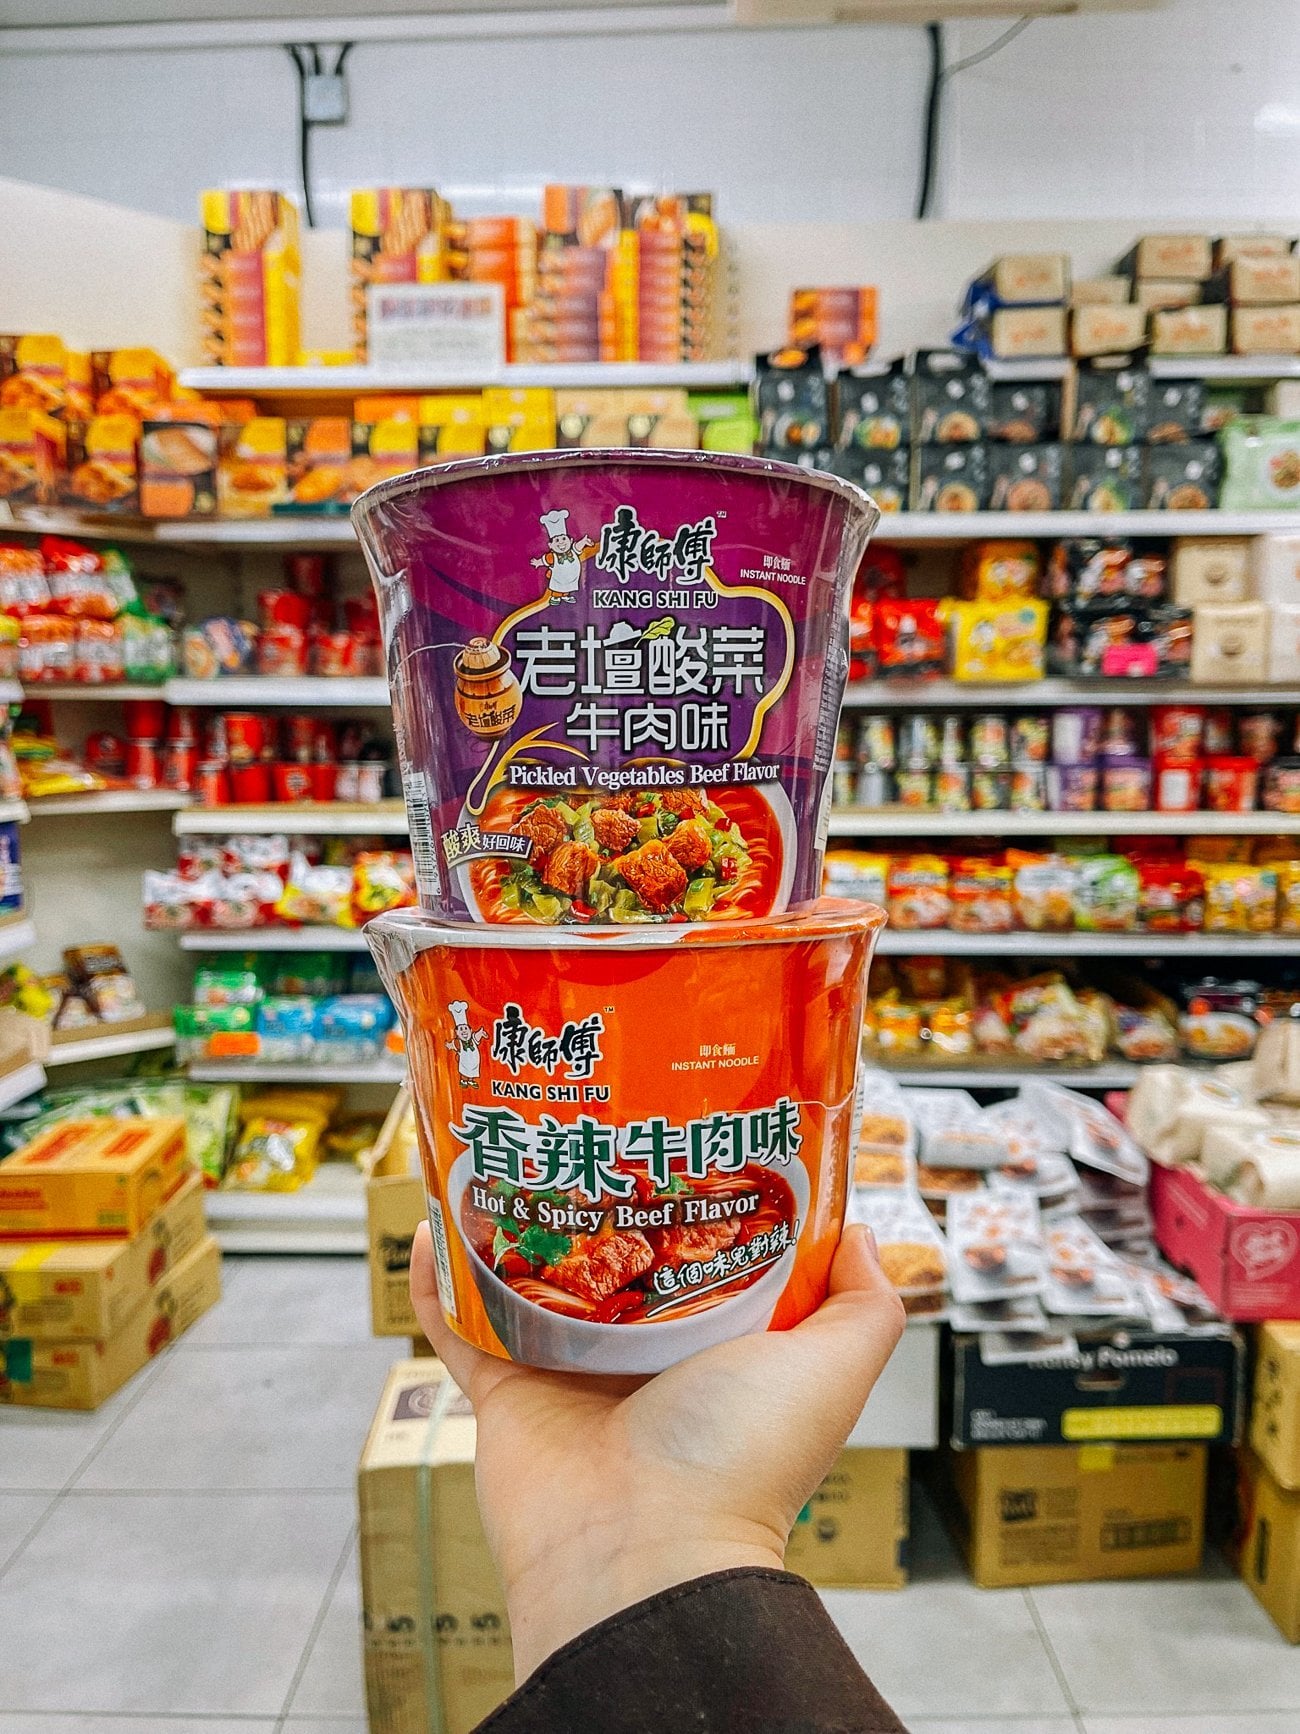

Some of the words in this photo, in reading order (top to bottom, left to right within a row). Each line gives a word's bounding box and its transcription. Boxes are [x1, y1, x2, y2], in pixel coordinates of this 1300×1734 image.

[597, 506, 716, 584] 康師傅
[740, 569, 777, 583] INSTANT
[777, 573, 806, 586] NOODLE
[594, 590, 652, 608] KANG
[655, 590, 689, 608] SHI
[694, 590, 718, 608] FU
[516, 622, 765, 696] 老壇酸菜
[566, 702, 729, 751] 牛肉味
[509, 765, 577, 787] Pickled
[581, 765, 685, 791] Vegetables
[689, 764, 730, 784] Beef
[732, 762, 780, 782] Flavor
[492, 1003, 604, 1079] 康師傅
[671, 1059, 716, 1072] INSTANT
[718, 1055, 760, 1070] NOODLE
[491, 1081, 541, 1100] KANG
[547, 1085, 578, 1101] SHI
[584, 1085, 610, 1101] FU
[450, 1098, 801, 1201] 香辣牛肉味
[472, 1186, 507, 1216] Hot
[513, 1204, 530, 1219] &
[538, 1201, 604, 1231] Spicy
[616, 1204, 673, 1228] Beef
[685, 1193, 760, 1223] Flavor
[1098, 1345, 1179, 1368] Pomelo
